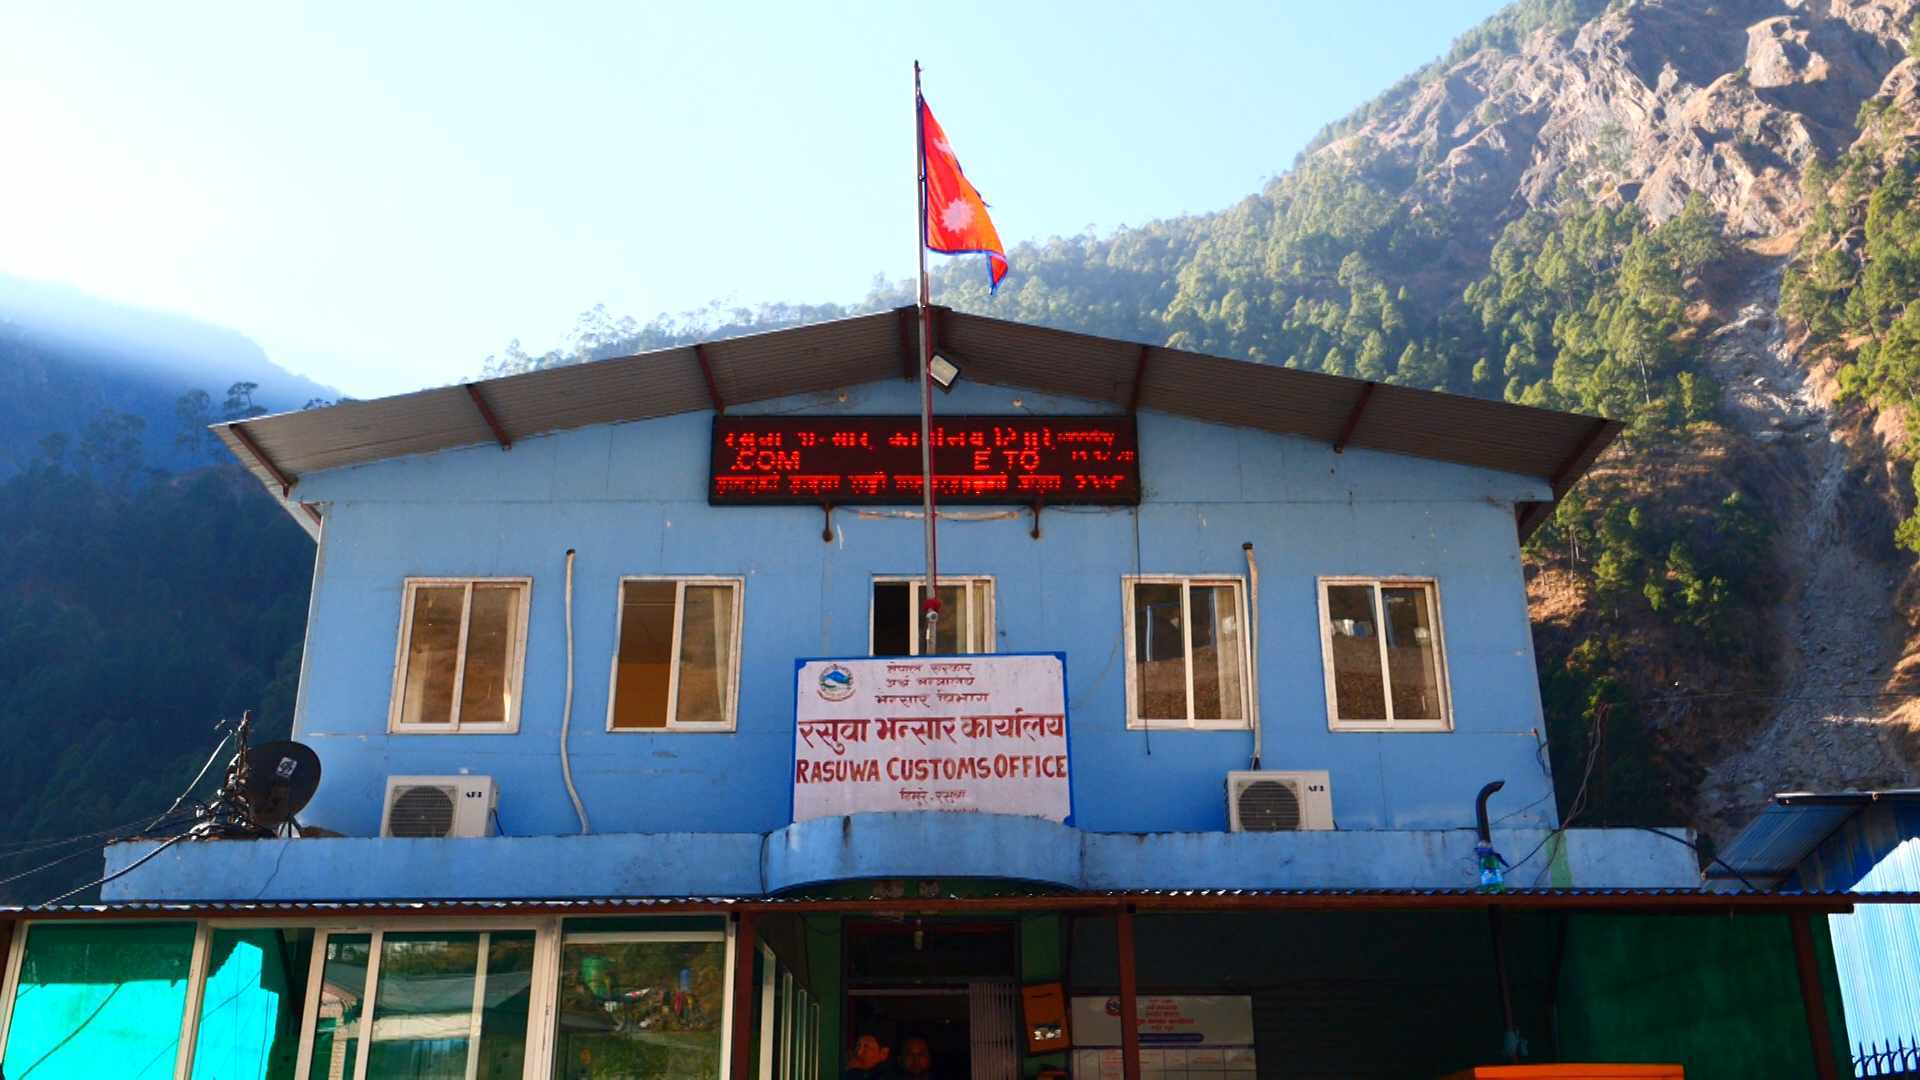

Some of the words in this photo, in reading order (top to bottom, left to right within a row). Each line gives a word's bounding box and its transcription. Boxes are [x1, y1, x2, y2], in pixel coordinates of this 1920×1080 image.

[798, 718, 872, 755] रसुवा
[875, 715, 956, 746] भन्सार
[961, 707, 1065, 741] कार्यालय
[796, 758, 881, 784] RASUWA
[886, 754, 992, 782] CUSTOMS
[994, 753, 1068, 779] OFFICE
